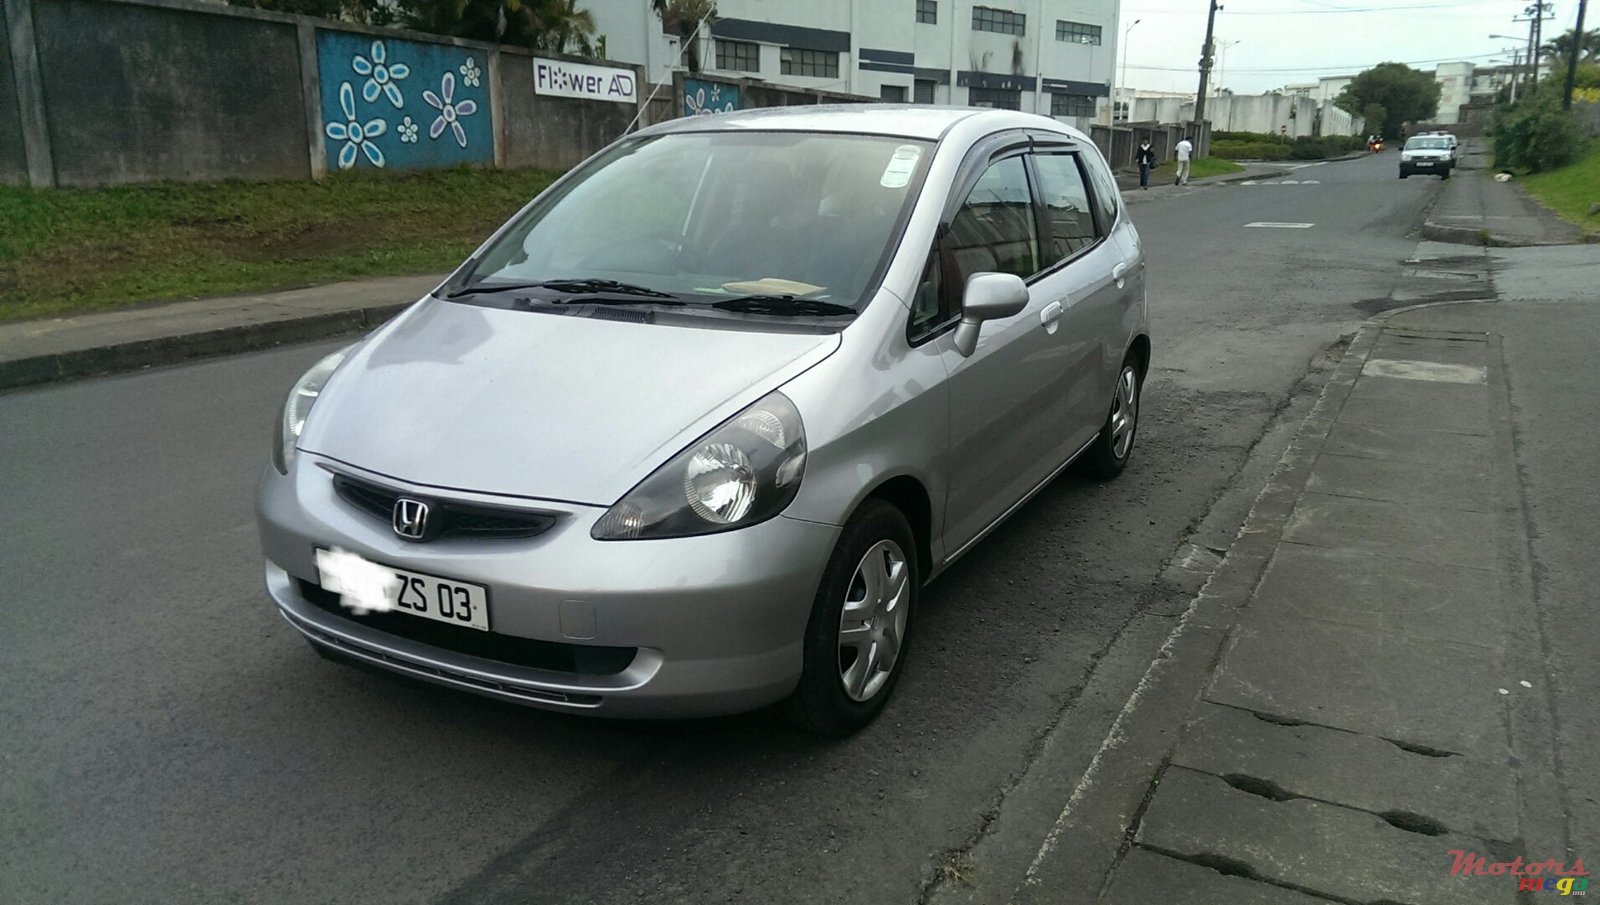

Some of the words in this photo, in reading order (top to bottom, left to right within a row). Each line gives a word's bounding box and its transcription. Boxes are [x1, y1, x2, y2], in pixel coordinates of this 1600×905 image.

[607, 74, 634, 97] AD
[395, 573, 428, 612] ZS
[437, 583, 472, 622] 03
